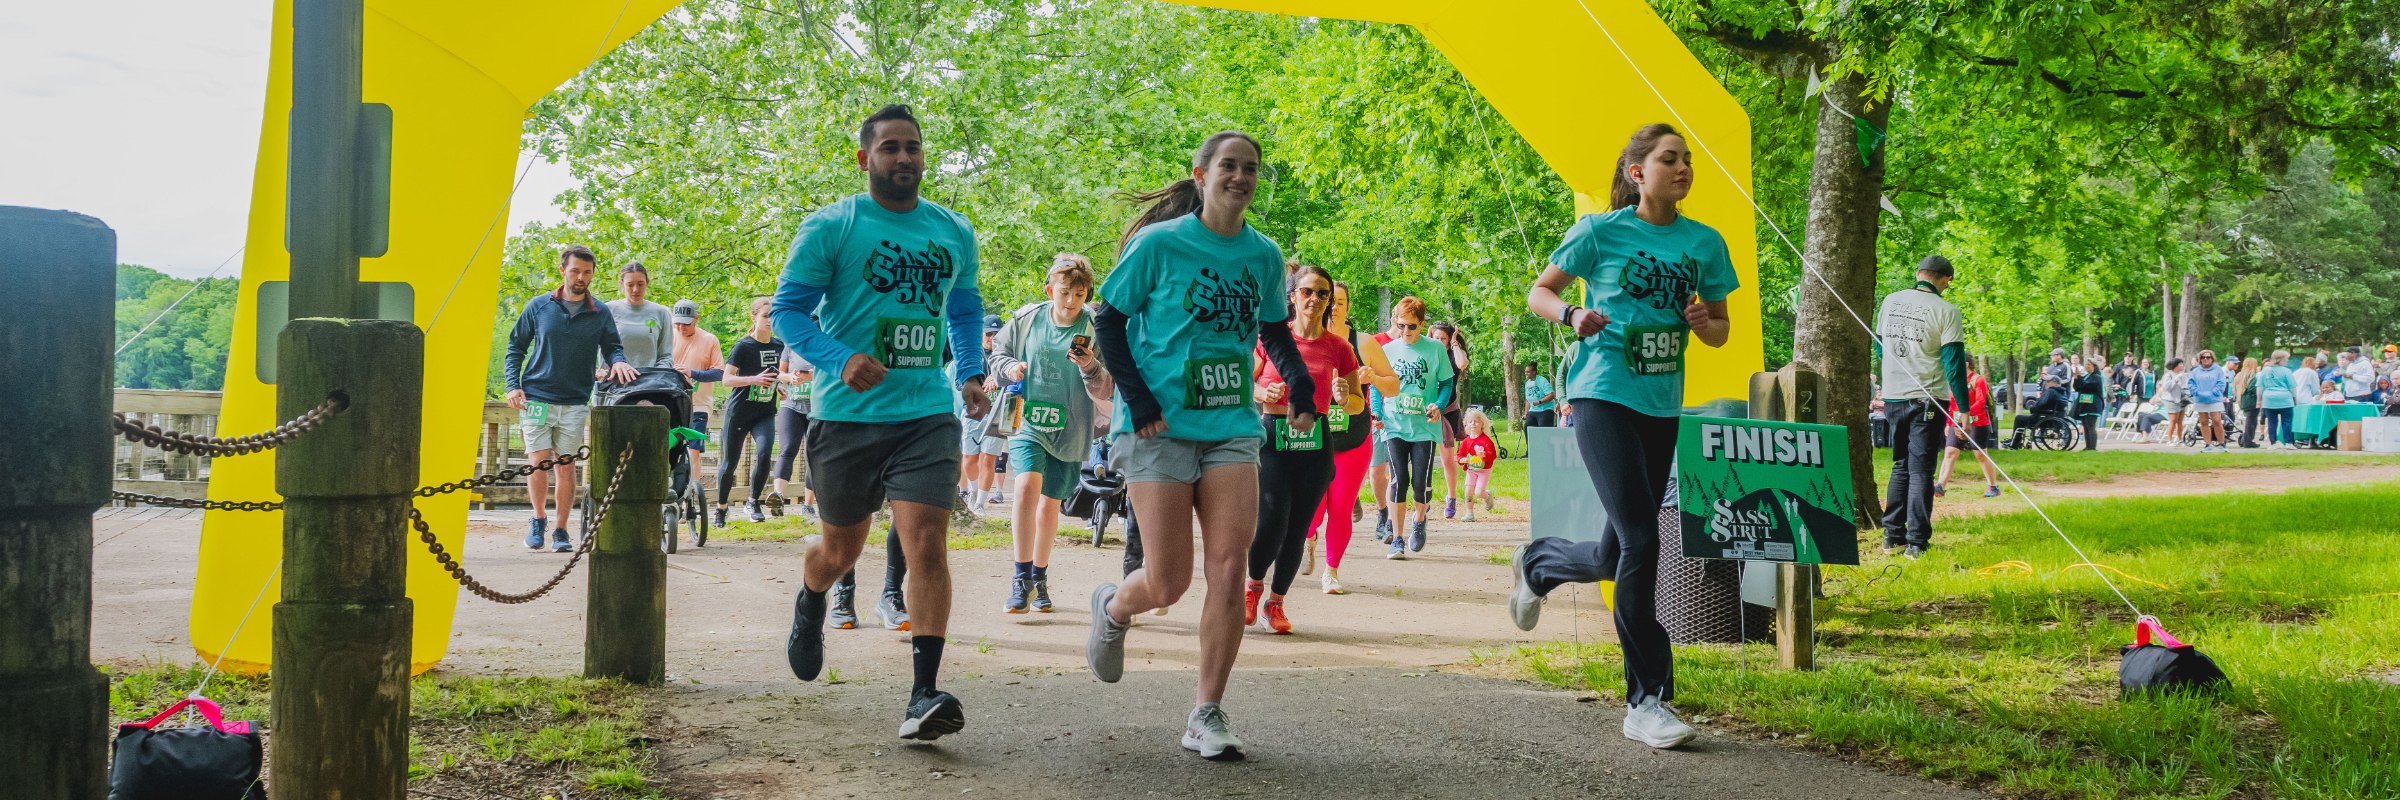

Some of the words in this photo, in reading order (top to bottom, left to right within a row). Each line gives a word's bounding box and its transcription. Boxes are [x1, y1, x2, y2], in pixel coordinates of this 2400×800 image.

[877, 240, 942, 269] SASS
[1634, 250, 1692, 280] SASS
[871, 256, 941, 293] STRUT
[1196, 267, 1253, 298] SASS
[1627, 264, 1690, 299] STRUT
[896, 282, 942, 317] 5K
[1192, 284, 1255, 322] STRUT
[894, 325, 936, 351] 606
[1213, 312, 1255, 342] 5K
[1641, 331, 1680, 359] 595
[897, 355, 932, 367] SUPPORTER
[1646, 361, 1677, 373] SUPPORTER
[1201, 363, 1242, 391] 605
[1206, 394, 1241, 407] SUPPORTER
[1403, 395, 1424, 408] 607
[1800, 390, 1813, 413] 2
[1030, 406, 1060, 424] 575
[1328, 408, 1345, 422] 25
[1288, 422, 1316, 439] 67
[1290, 441, 1316, 449] SUPPORTER
[1701, 423, 1823, 467] FINISH
[1713, 498, 1771, 525] SASS
[1711, 513, 1772, 542] STRUT
